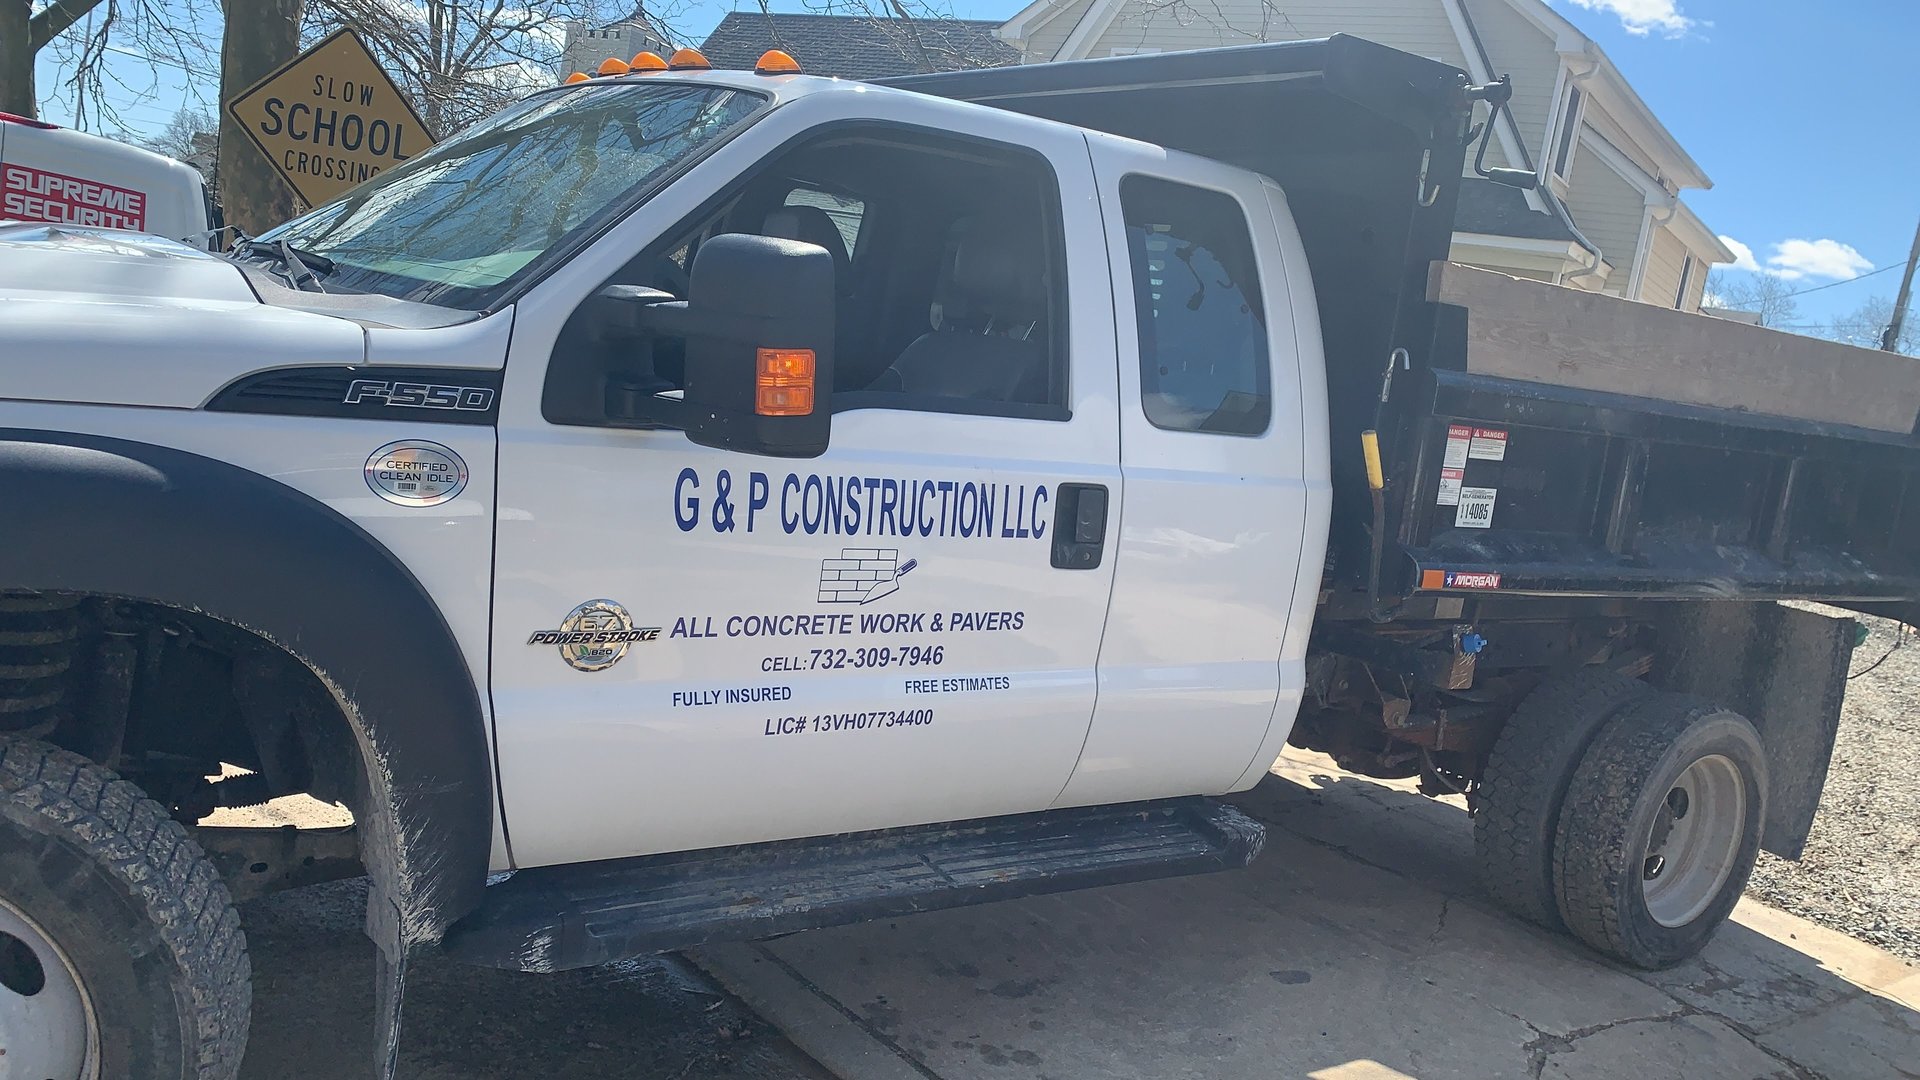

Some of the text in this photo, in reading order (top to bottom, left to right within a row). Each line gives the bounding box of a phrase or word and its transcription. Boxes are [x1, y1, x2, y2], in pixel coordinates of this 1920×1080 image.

[313, 75, 374, 107] SLOW
[260, 97, 411, 161] SCHOOL
[5, 168, 142, 215] SUPREME
[3, 192, 140, 231] SECURITY
[343, 379, 495, 412] F-550
[1482, 430, 1505, 439] DANGER
[379, 471, 454, 483] CLEAN IDLE
[386, 460, 449, 472] CERTIFIED
[673, 466, 1049, 540] G & P CONSTRUCTION LLC
[1460, 502, 1490, 520] 114085
[1454, 573, 1500, 588] MORGAN
[530, 628, 662, 646] POWER STROKE
[669, 611, 1025, 639] ALL CONCRETE WORK & PAVERS
[761, 645, 945, 672] CELL: 732-309-7946
[672, 686, 792, 707] FULLY INSURED
[905, 676, 1010, 694] FREE ESTIMATES
[764, 709, 933, 735] LIC# 13VH07734400
